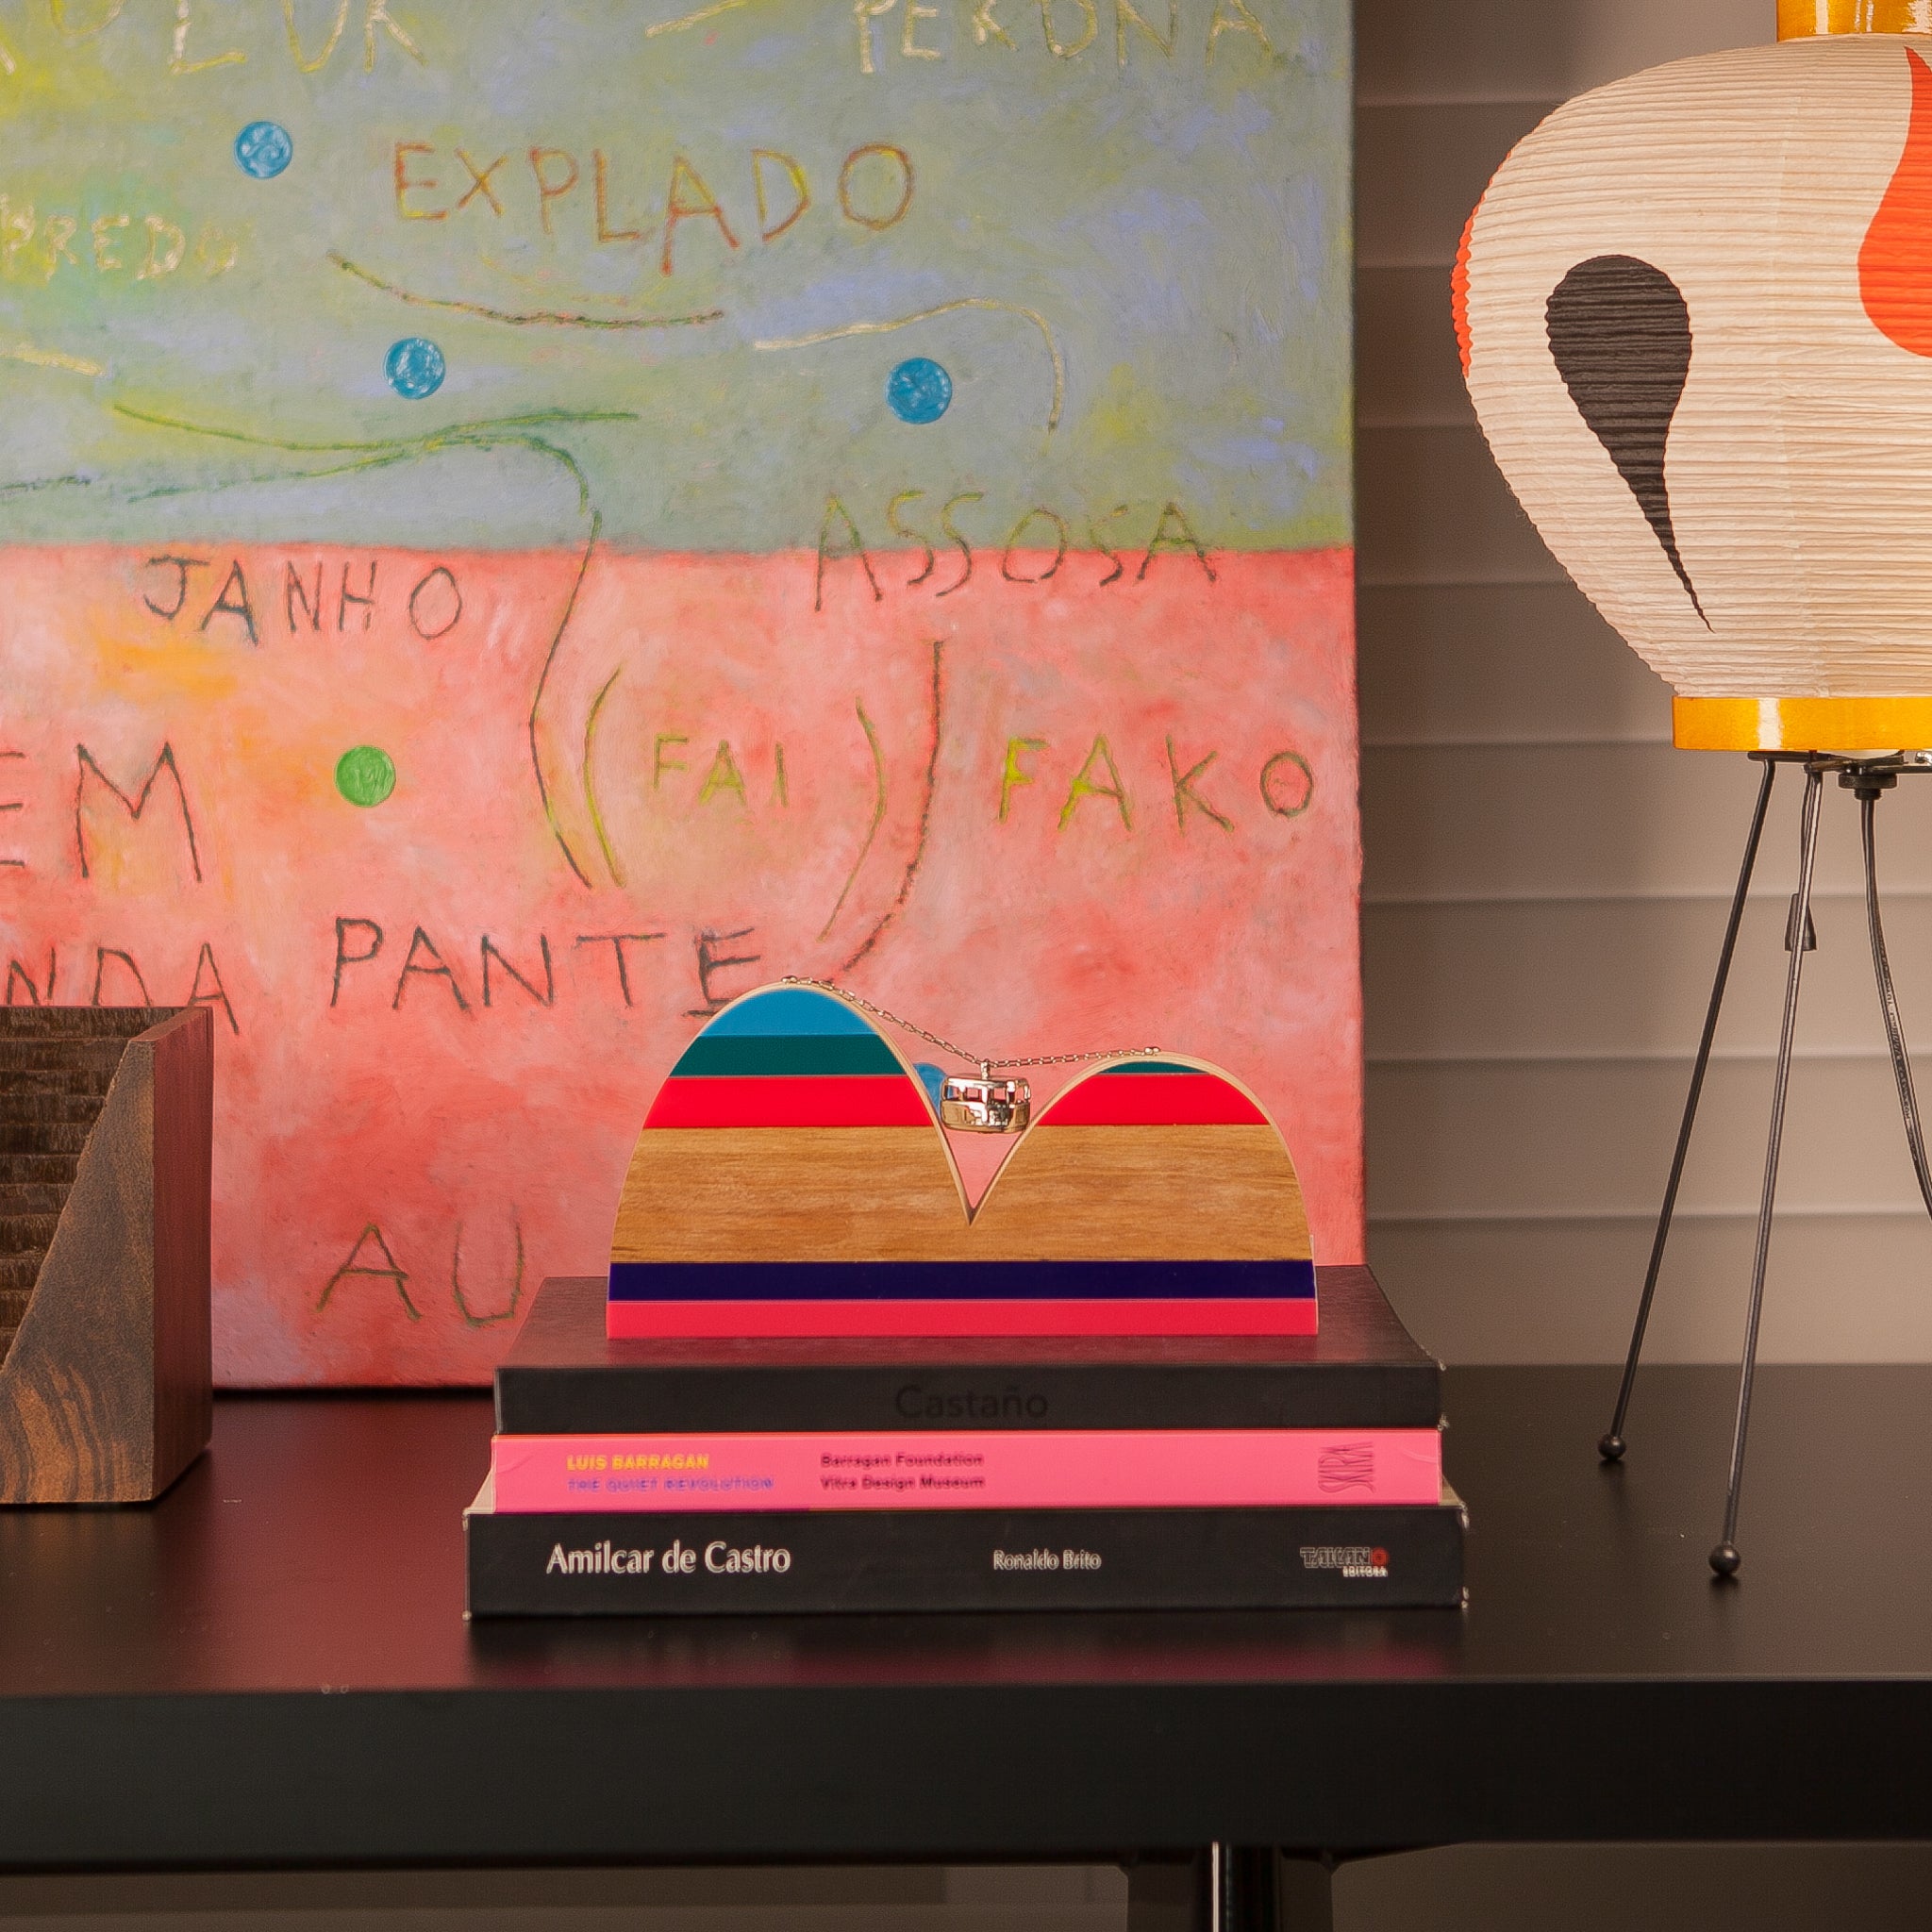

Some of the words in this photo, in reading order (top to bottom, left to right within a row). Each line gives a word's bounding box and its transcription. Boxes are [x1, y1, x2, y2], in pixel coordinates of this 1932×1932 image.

[394, 141, 914, 275] EXPLADO
[815, 491, 1218, 612] ASSOSA
[143, 555, 463, 646] JANHO
[997, 733, 1315, 834] FAKO
[329, 917, 761, 1017] PANTE
[314, 1204, 525, 1328] AU
[896, 1383, 1049, 1418] Castaño
[567, 1454, 608, 1472] LUIS
[895, 1453, 985, 1468] Foundation
[568, 1477, 600, 1492] THE
[606, 1477, 658, 1493] QUIET
[663, 1477, 774, 1492] REVOLUTION
[821, 1476, 858, 1491] Vitra
[861, 1475, 916, 1493] Design
[919, 1476, 986, 1491] Museum
[546, 1541, 655, 1574] Amilcar
[661, 1540, 697, 1574] de
[704, 1541, 791, 1574] Castro
[992, 1549, 1059, 1571] Ronaldo
[1062, 1549, 1102, 1570] Brito
